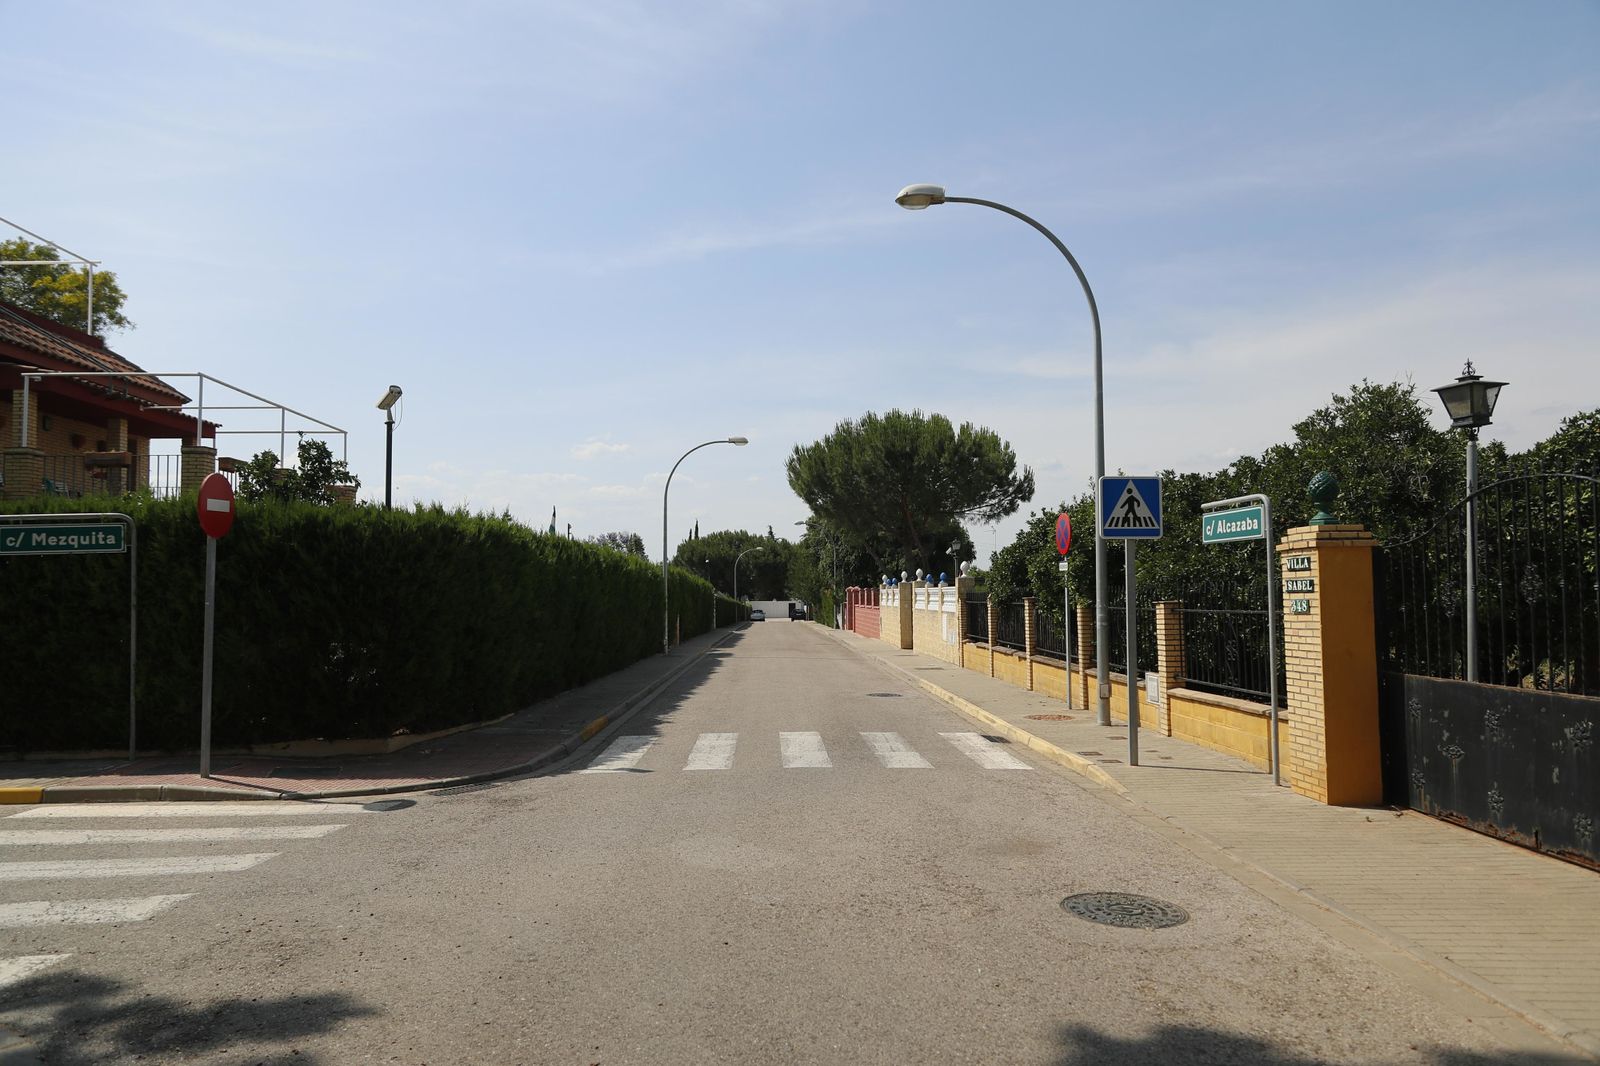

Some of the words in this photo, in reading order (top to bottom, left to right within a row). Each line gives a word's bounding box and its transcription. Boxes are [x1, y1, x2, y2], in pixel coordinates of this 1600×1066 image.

[1206, 520, 1214, 536] c/
[1217, 517, 1258, 534] Alcazaba
[6, 532, 24, 547] c/
[31, 532, 116, 548] Mezquita
[1286, 558, 1308, 569] VILLA
